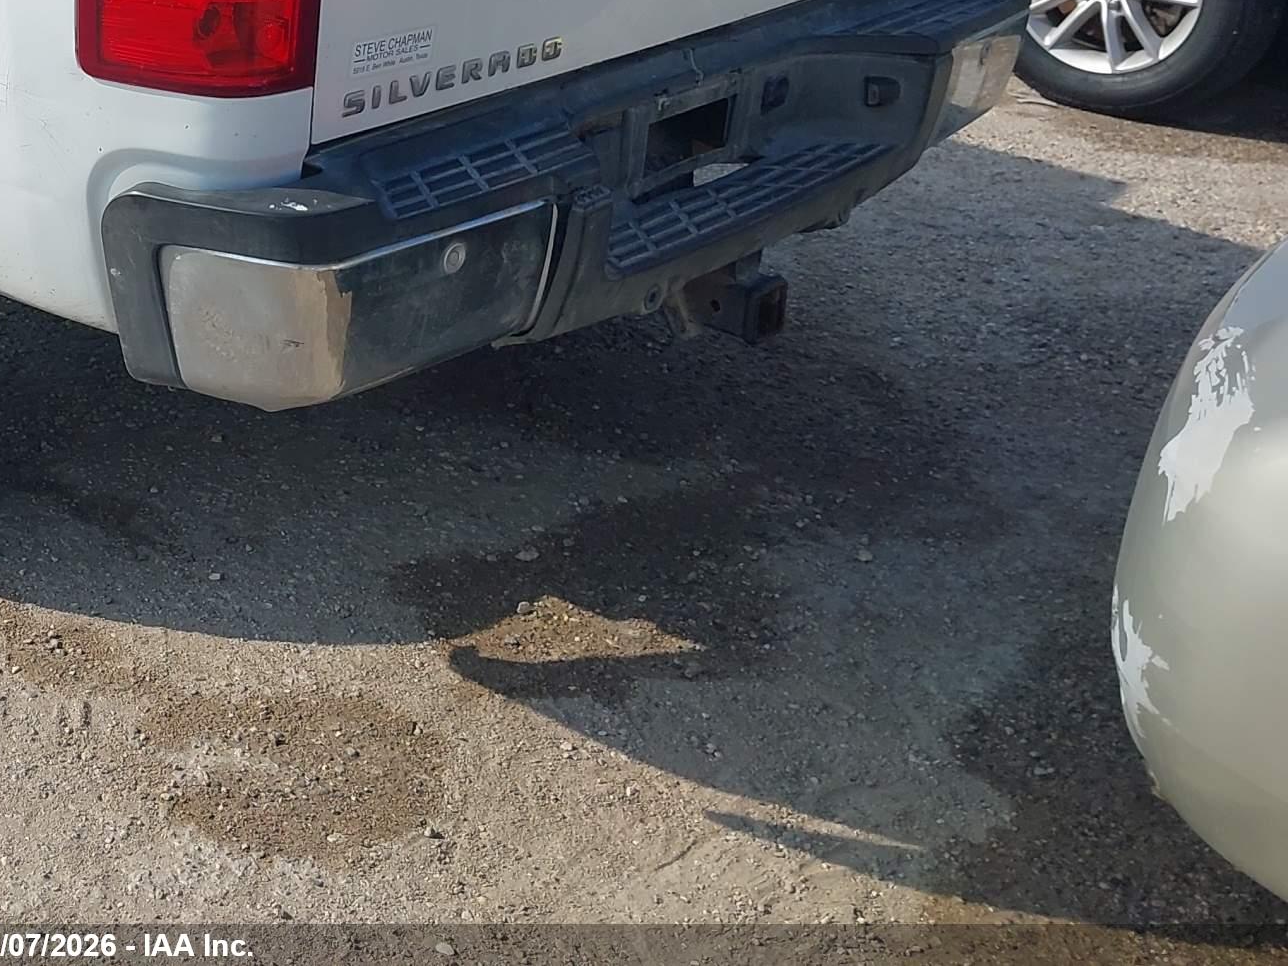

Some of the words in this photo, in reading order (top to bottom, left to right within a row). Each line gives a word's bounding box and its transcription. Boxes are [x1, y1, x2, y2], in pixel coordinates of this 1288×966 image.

[355, 40, 386, 57] STEVE
[388, 29, 433, 50] CHAPMAN
[367, 50, 394, 61] MOTOR
[395, 44, 419, 56] SALES
[341, 35, 563, 118] SILVERADO
